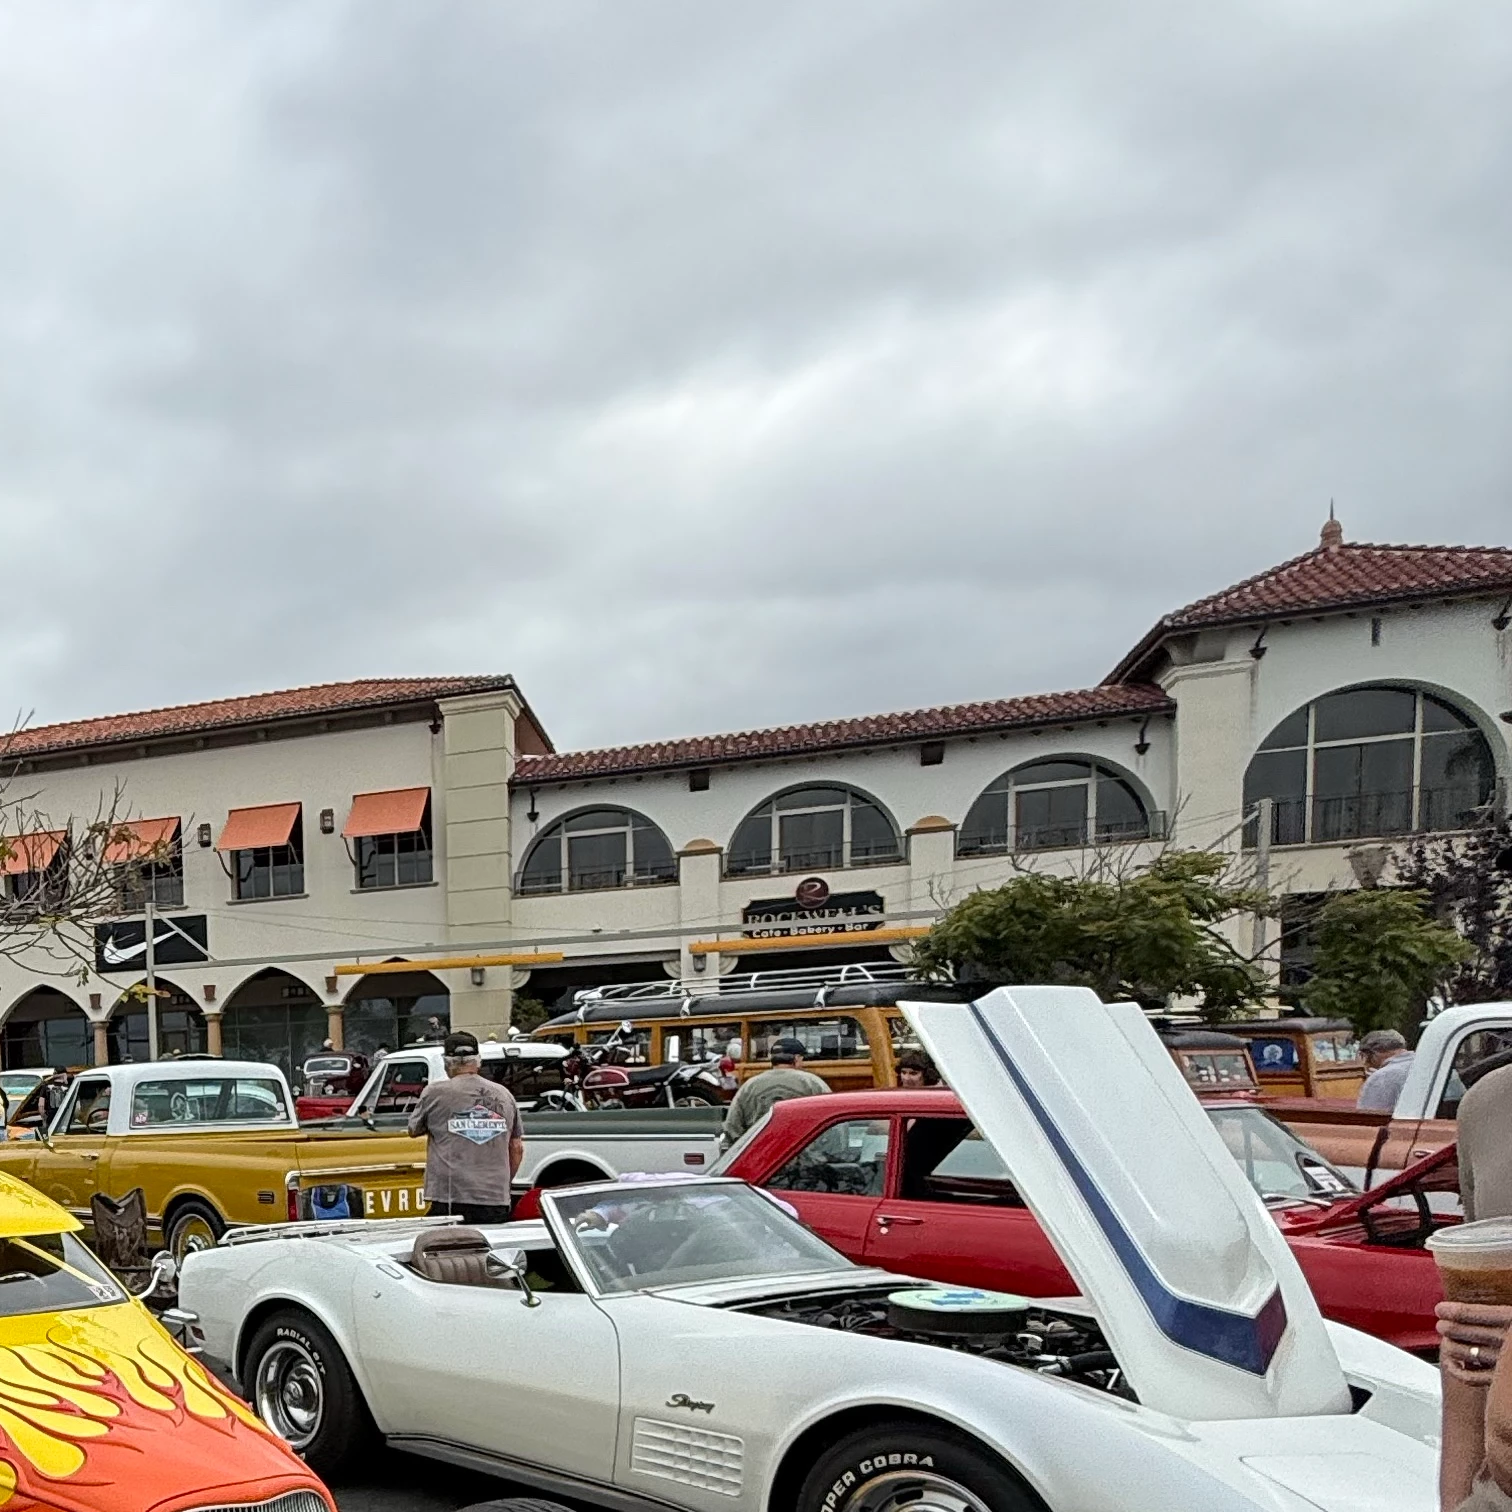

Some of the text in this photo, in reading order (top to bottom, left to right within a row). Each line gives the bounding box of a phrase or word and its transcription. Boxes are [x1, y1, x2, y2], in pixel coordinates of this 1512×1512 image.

[790, 926, 835, 936] Bakery
[845, 922, 869, 931] Bar
[277, 1328, 311, 1350] RADIAL
[859, 1453, 934, 1476] COBRA
